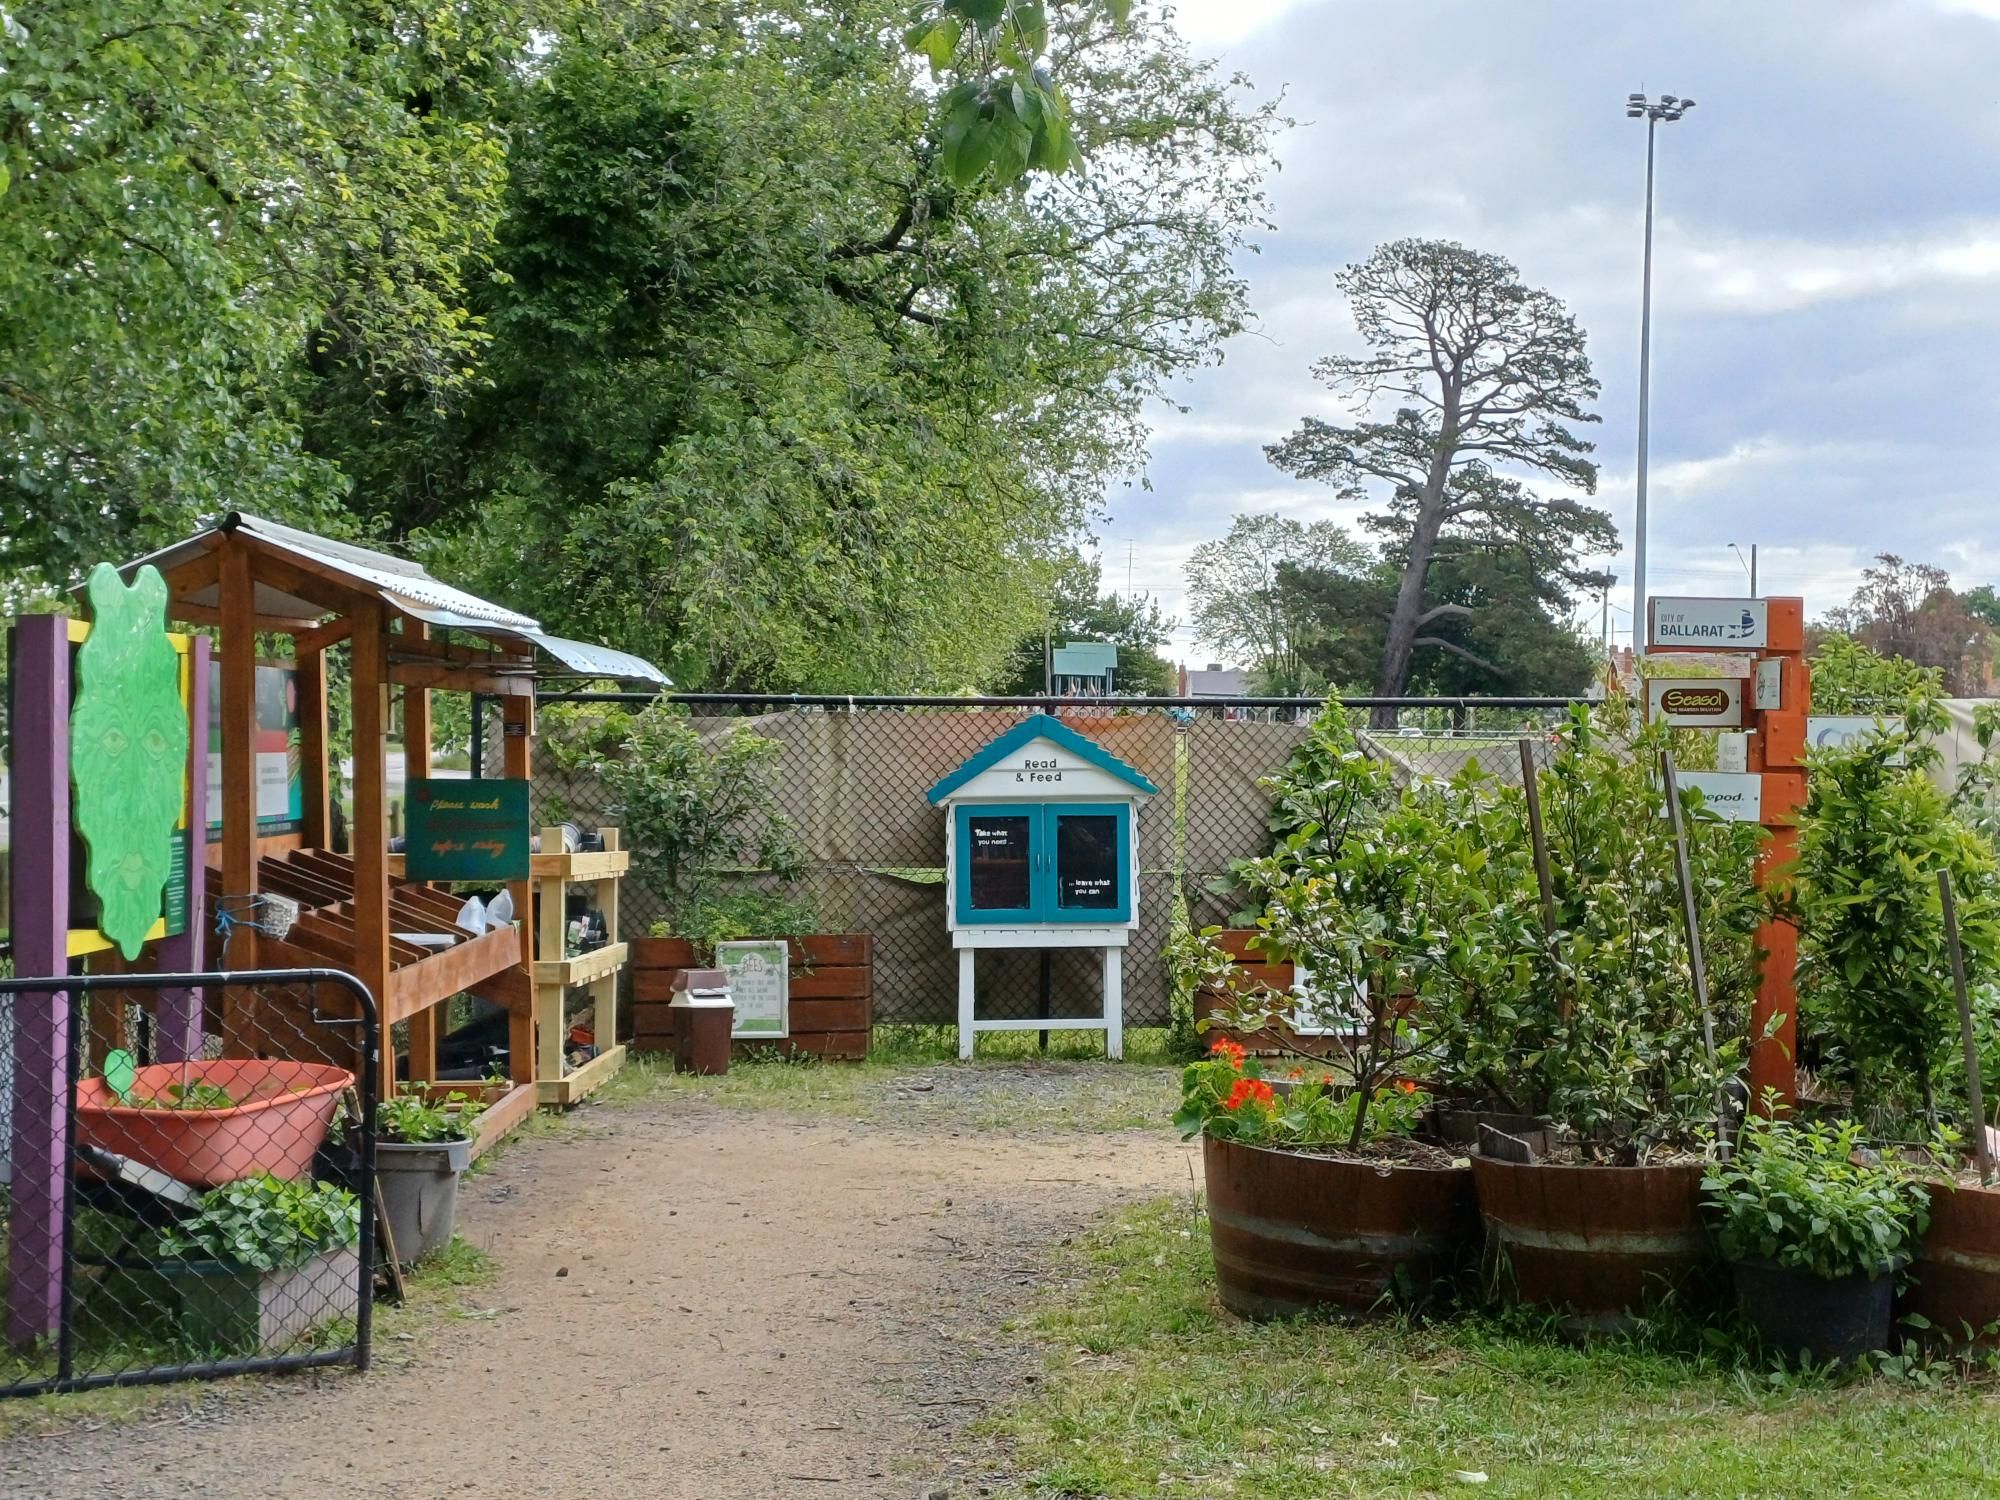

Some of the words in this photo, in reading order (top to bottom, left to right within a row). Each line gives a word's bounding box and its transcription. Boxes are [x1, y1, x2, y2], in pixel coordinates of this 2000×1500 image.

[1677, 614, 1685, 622] OF
[1661, 624, 1724, 637] BALLARAT
[1668, 691, 1722, 706] Seasol
[1025, 759, 1057, 769] Read
[1016, 772, 1024, 782] &
[1030, 772, 1062, 782] Feed
[430, 799, 464, 811] Please
[975, 828, 990, 837] Take
